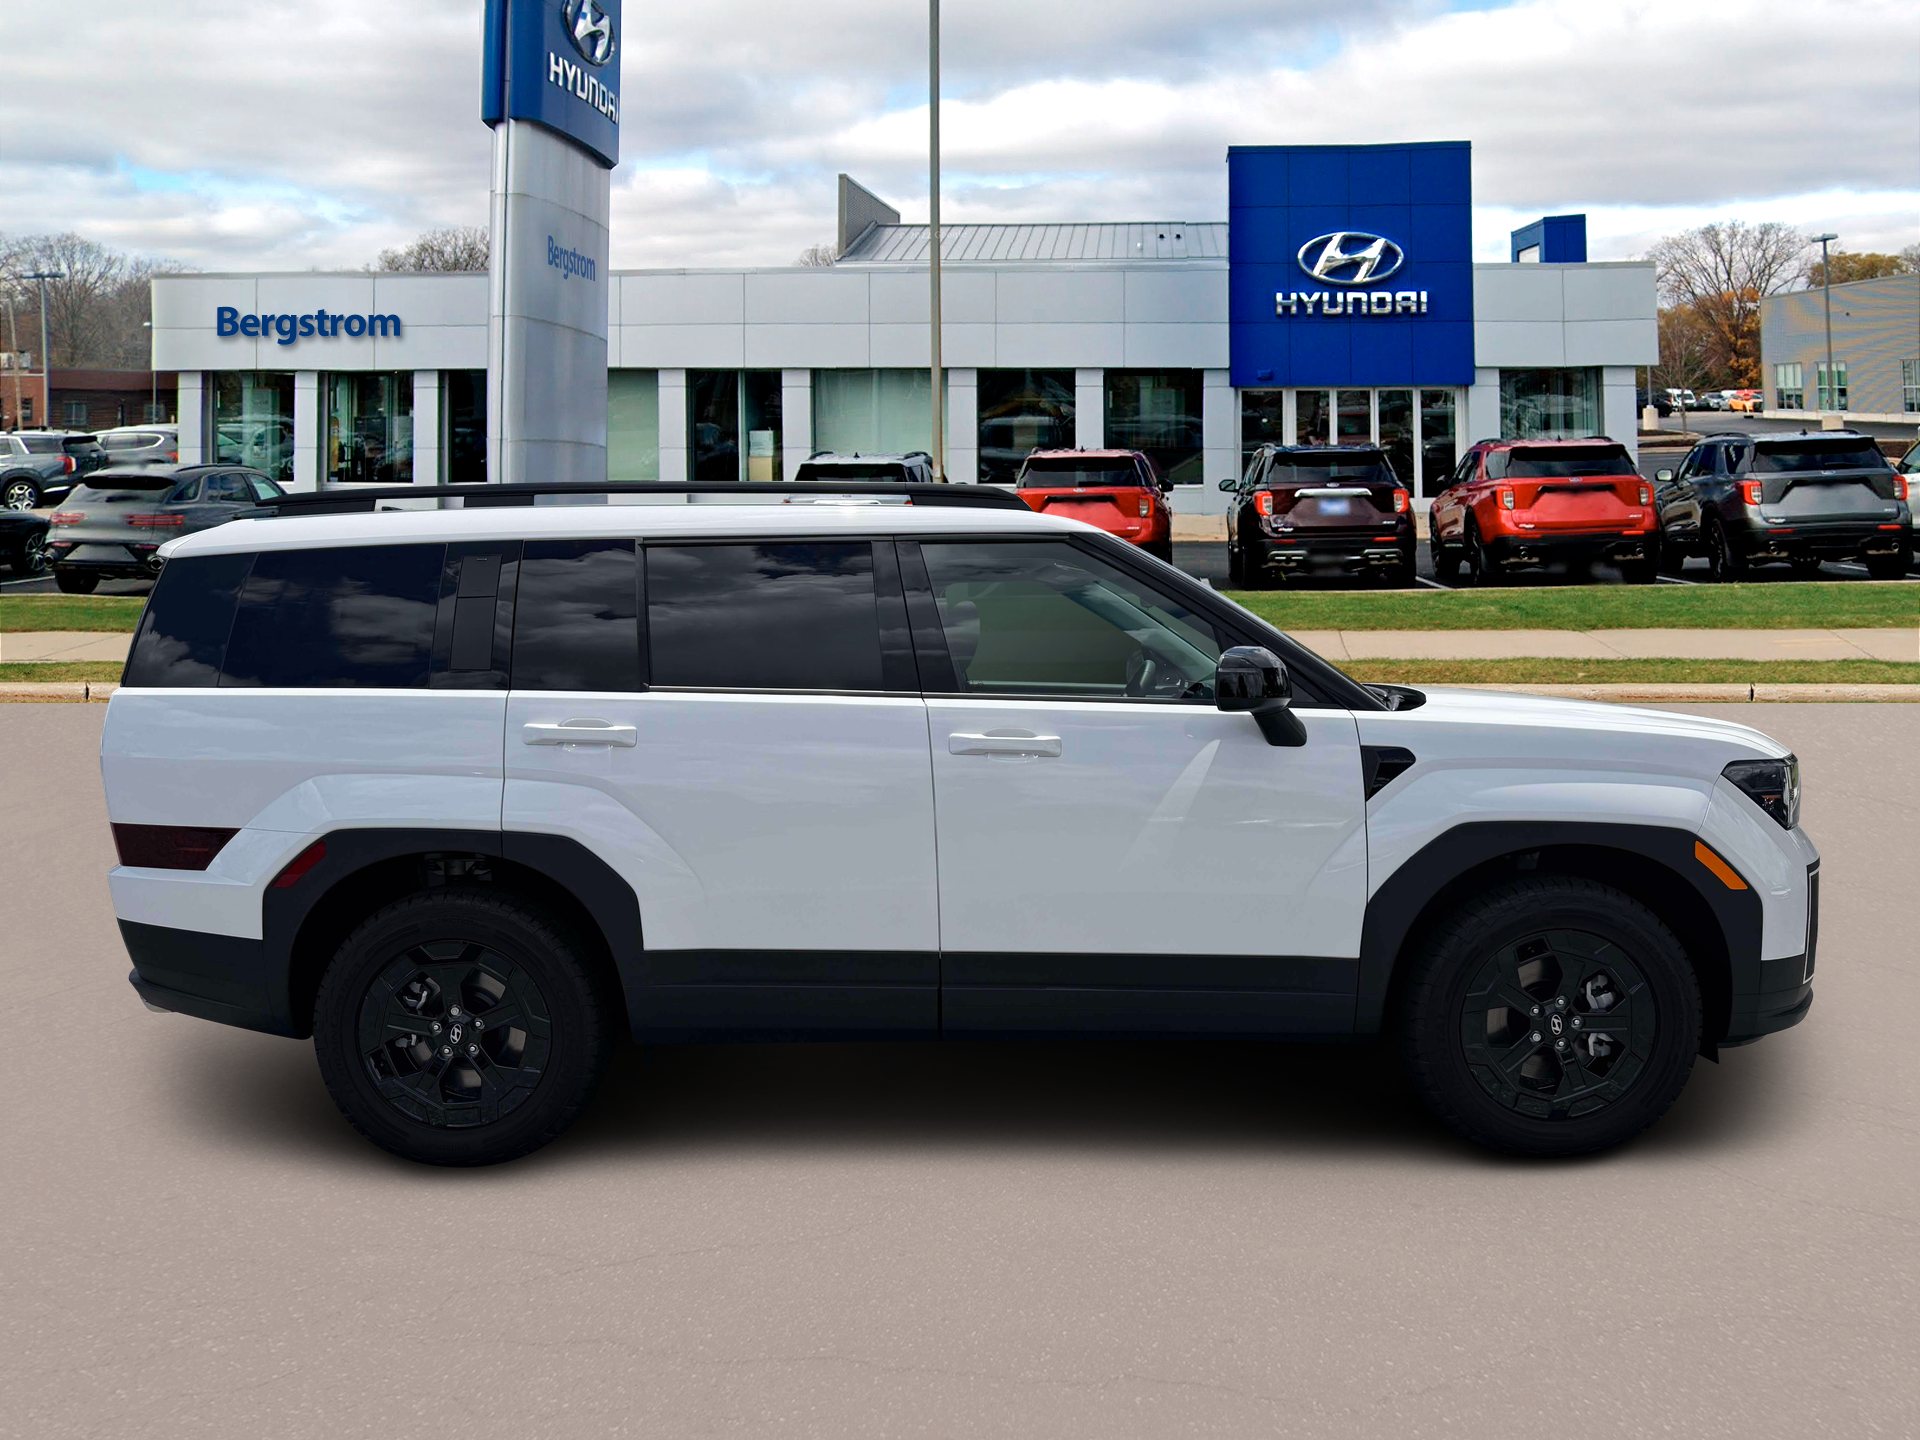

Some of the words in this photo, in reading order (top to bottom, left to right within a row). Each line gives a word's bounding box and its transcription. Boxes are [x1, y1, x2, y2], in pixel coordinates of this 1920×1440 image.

[549, 51, 619, 124] HYUNDAI
[547, 235, 596, 282] Bergstrom
[1275, 290, 1428, 316] HYUNDAI
[217, 306, 401, 346] Bergstrom
